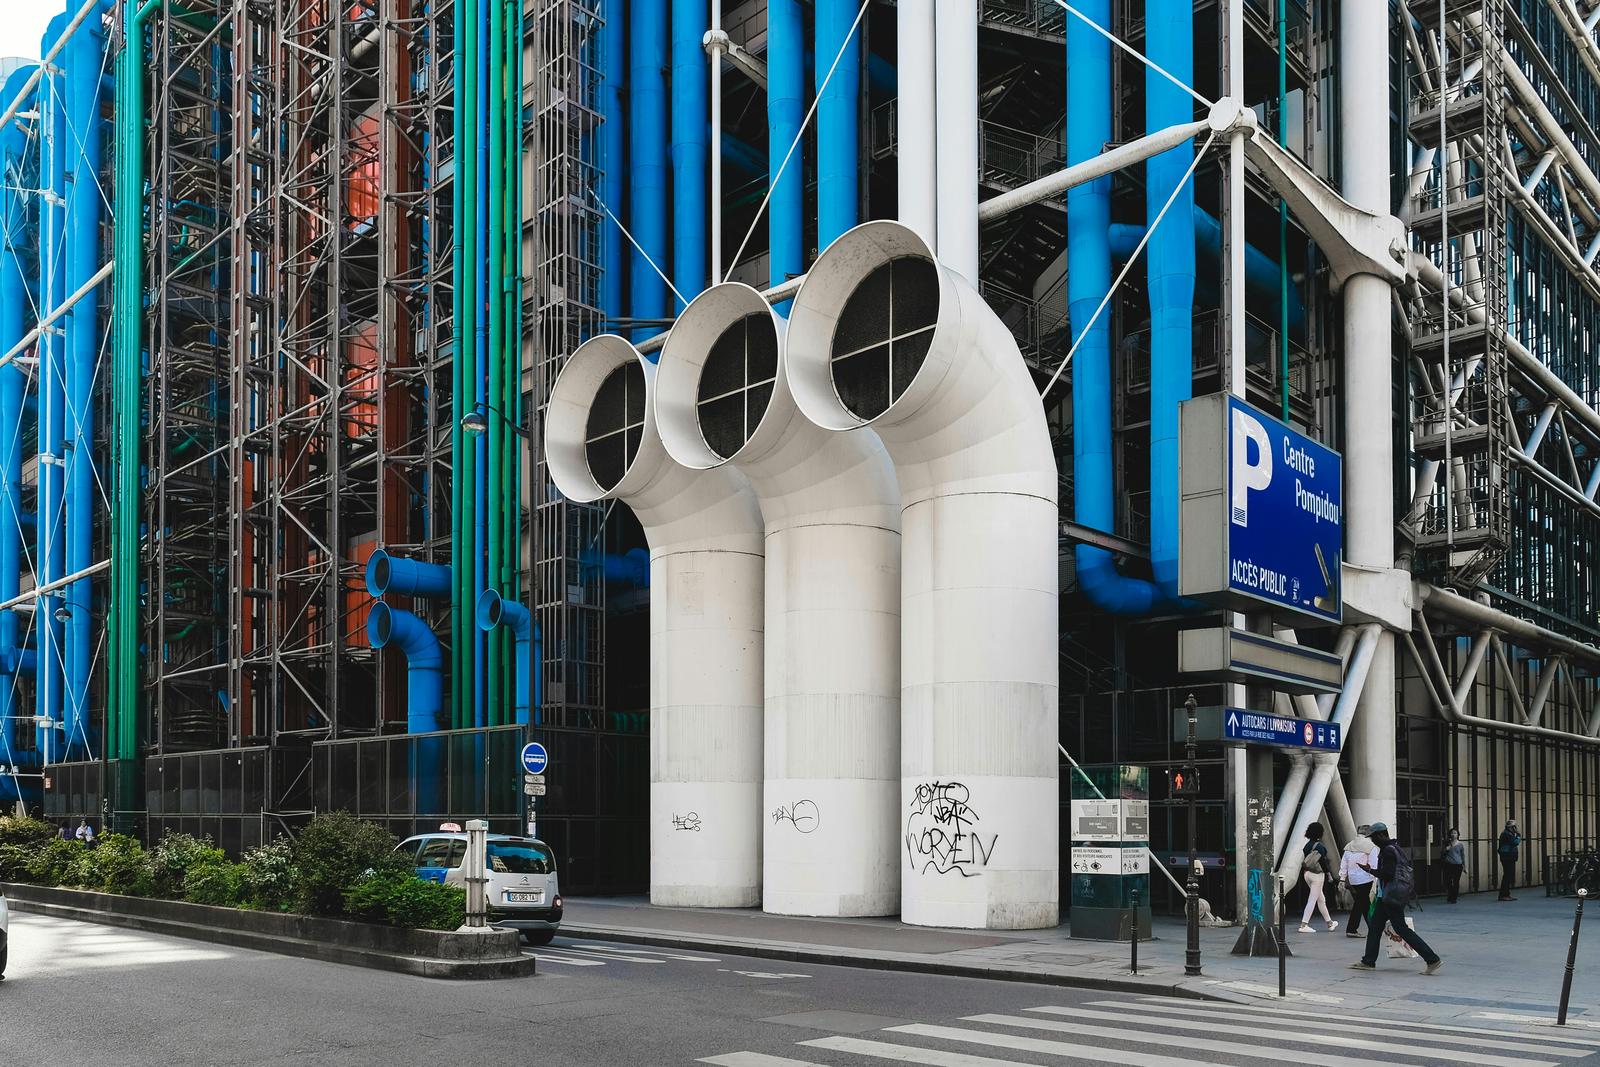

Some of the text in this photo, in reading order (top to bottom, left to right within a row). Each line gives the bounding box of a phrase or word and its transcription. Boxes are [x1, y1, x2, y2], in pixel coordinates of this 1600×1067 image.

[1232, 407, 1273, 528] P
[1284, 435, 1315, 479] Centre
[1295, 478, 1339, 526] Pompidou
[1232, 558, 1258, 588] ACCÈS
[1259, 567, 1287, 597] PUBLIC
[1242, 714, 1267, 730] AUTOCARS
[1270, 718, 1296, 734] LIVRAISONS
